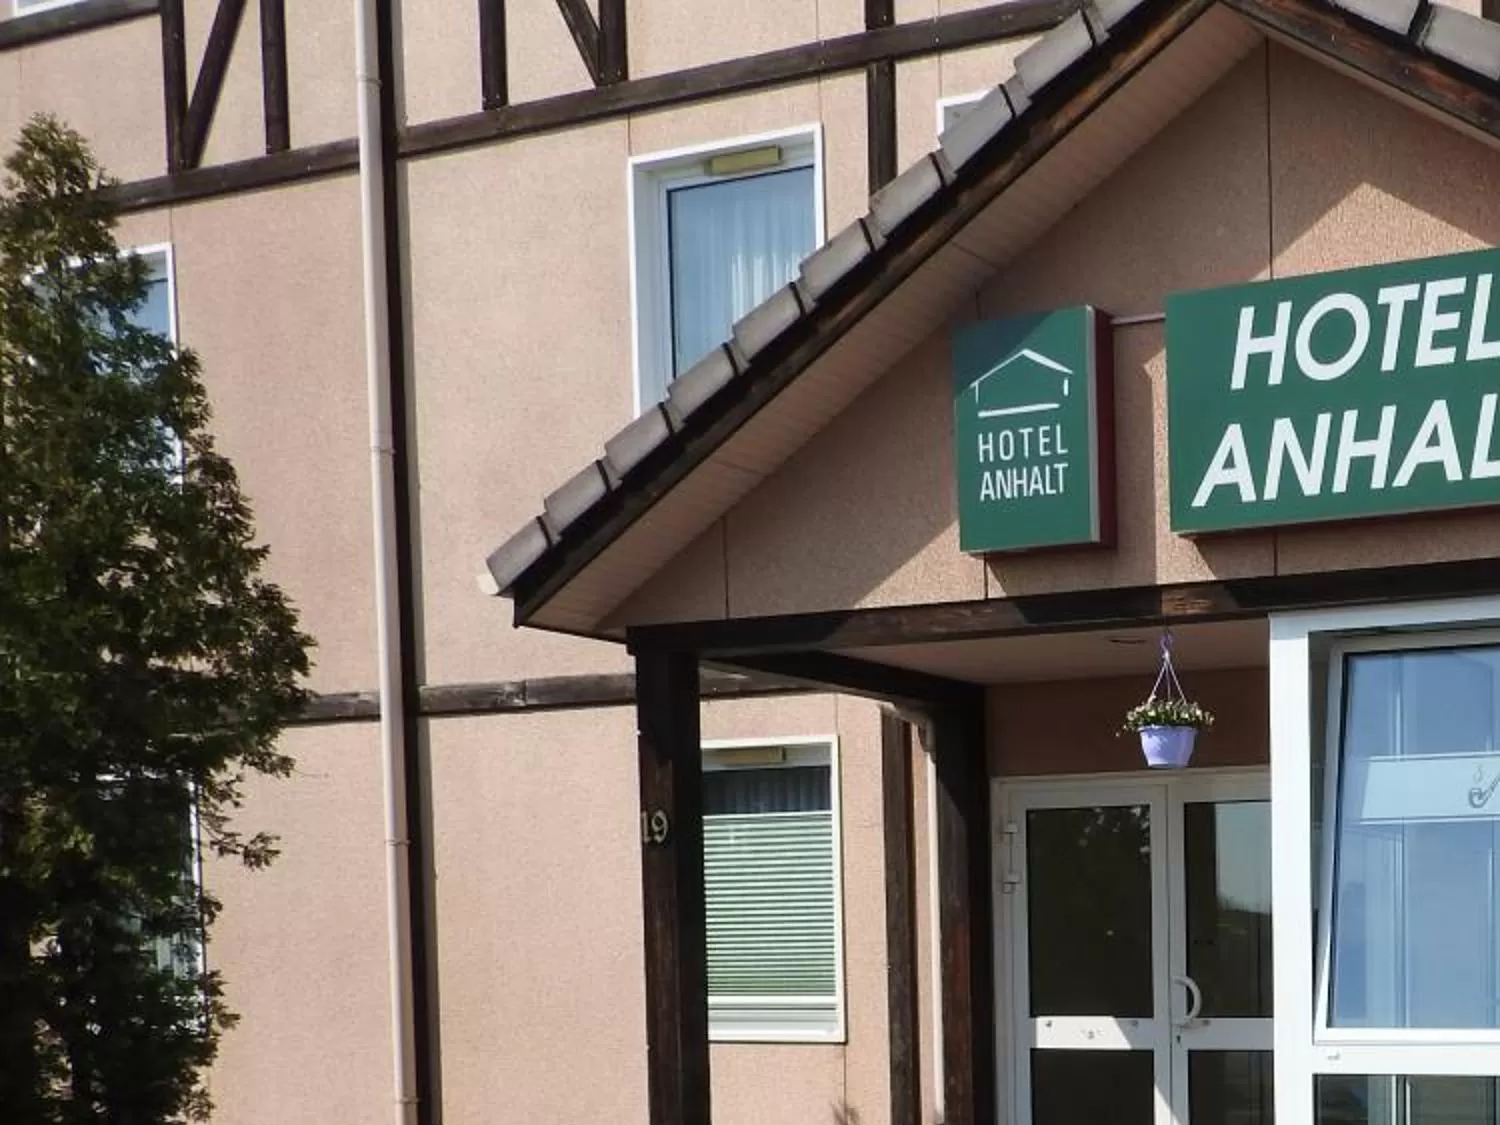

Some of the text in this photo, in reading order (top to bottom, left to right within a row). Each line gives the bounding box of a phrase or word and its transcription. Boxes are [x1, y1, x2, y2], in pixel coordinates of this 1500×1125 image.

[978, 424, 1068, 462] HOTEL
[979, 463, 1068, 502] ANHALT
[641, 809, 668, 843] 19
